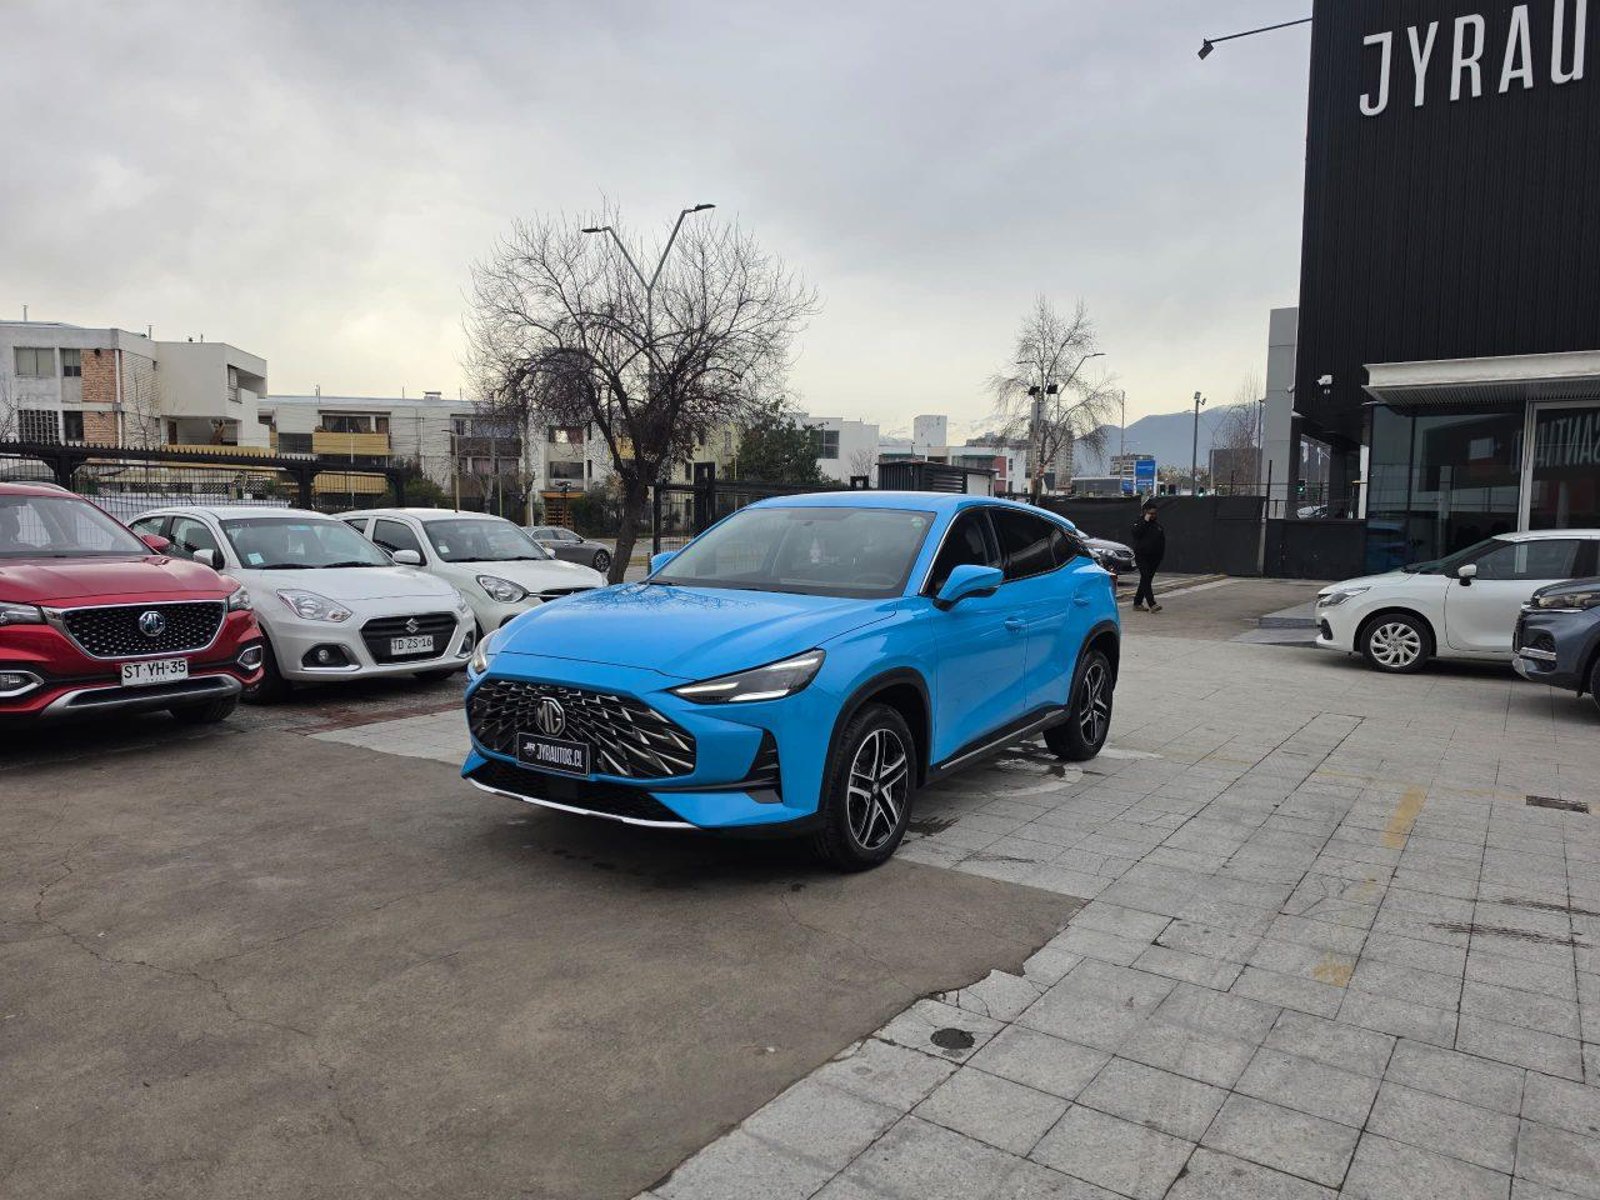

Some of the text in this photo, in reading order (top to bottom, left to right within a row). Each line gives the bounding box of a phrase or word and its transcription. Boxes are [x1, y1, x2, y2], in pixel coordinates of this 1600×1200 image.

[1360, 0, 1587, 116] JYRAU
[537, 700, 562, 734] MG
[536, 743, 583, 768] JYRAUTOS.CL
